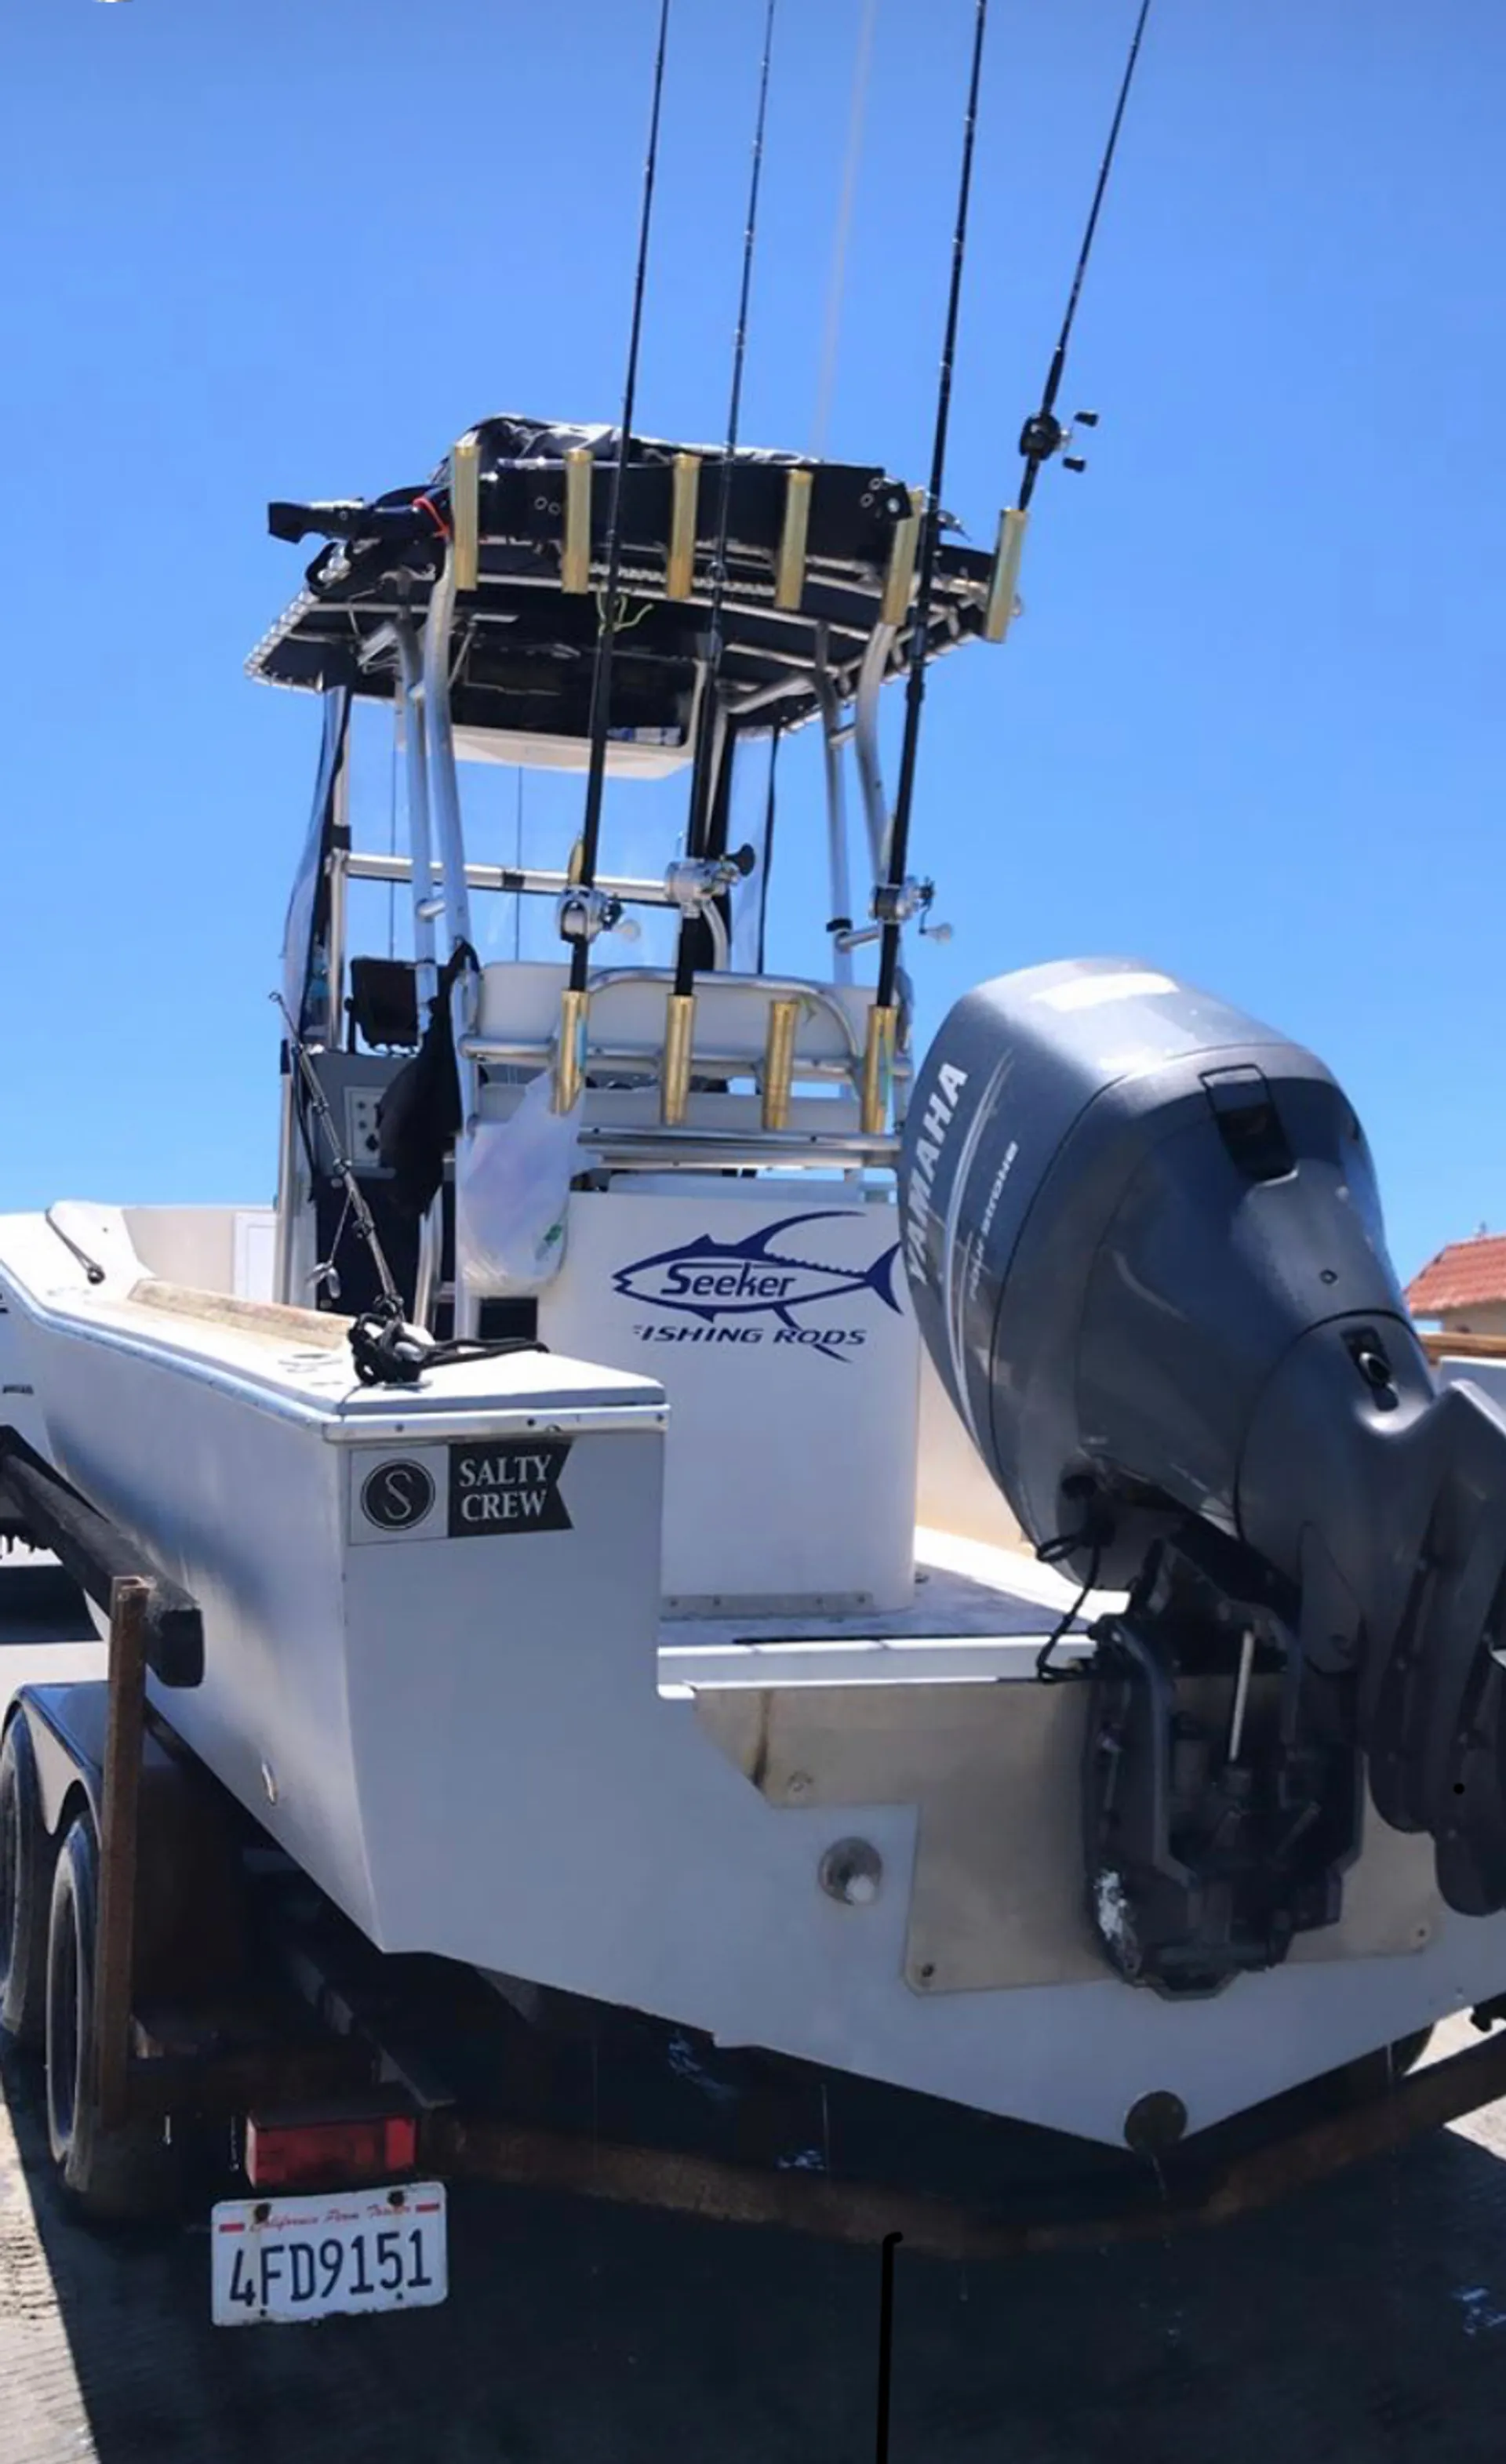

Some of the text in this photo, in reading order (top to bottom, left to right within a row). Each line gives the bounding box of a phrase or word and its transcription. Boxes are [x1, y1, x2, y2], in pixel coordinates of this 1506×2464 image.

[908, 1063, 968, 1286] YAMAHA
[660, 1262, 795, 1297] Seeker
[460, 1455, 551, 1487] SALTY
[461, 1489, 547, 1521] CREW
[229, 2228, 432, 2307] 4FD9151
